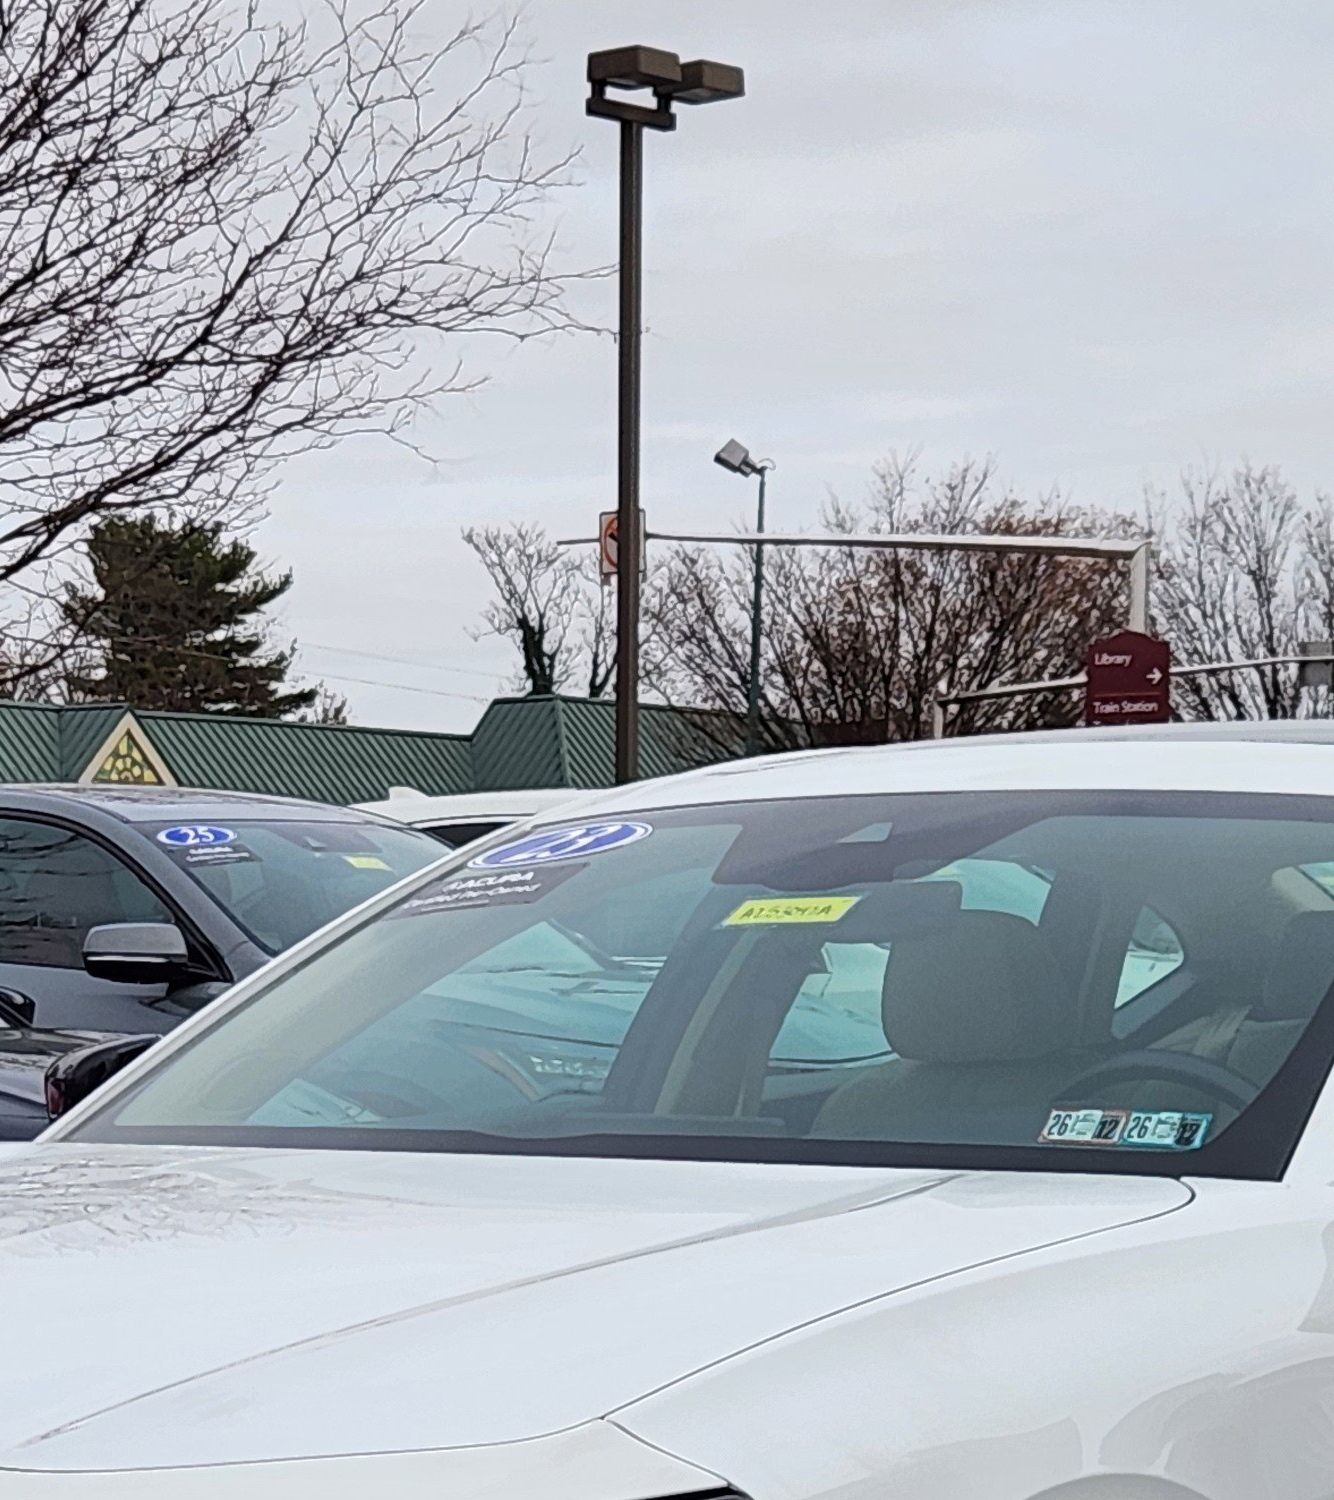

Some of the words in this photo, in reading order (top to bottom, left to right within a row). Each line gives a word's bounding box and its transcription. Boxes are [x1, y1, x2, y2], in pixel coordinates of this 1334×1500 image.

[1094, 652, 1132, 668] Library
[1093, 702, 1120, 714] Train
[1121, 701, 1158, 713] Station
[180, 828, 215, 845] 25
[1048, 1113, 1073, 1136] 26
[1095, 1119, 1121, 1140] 12
[1127, 1115, 1153, 1139] 26
